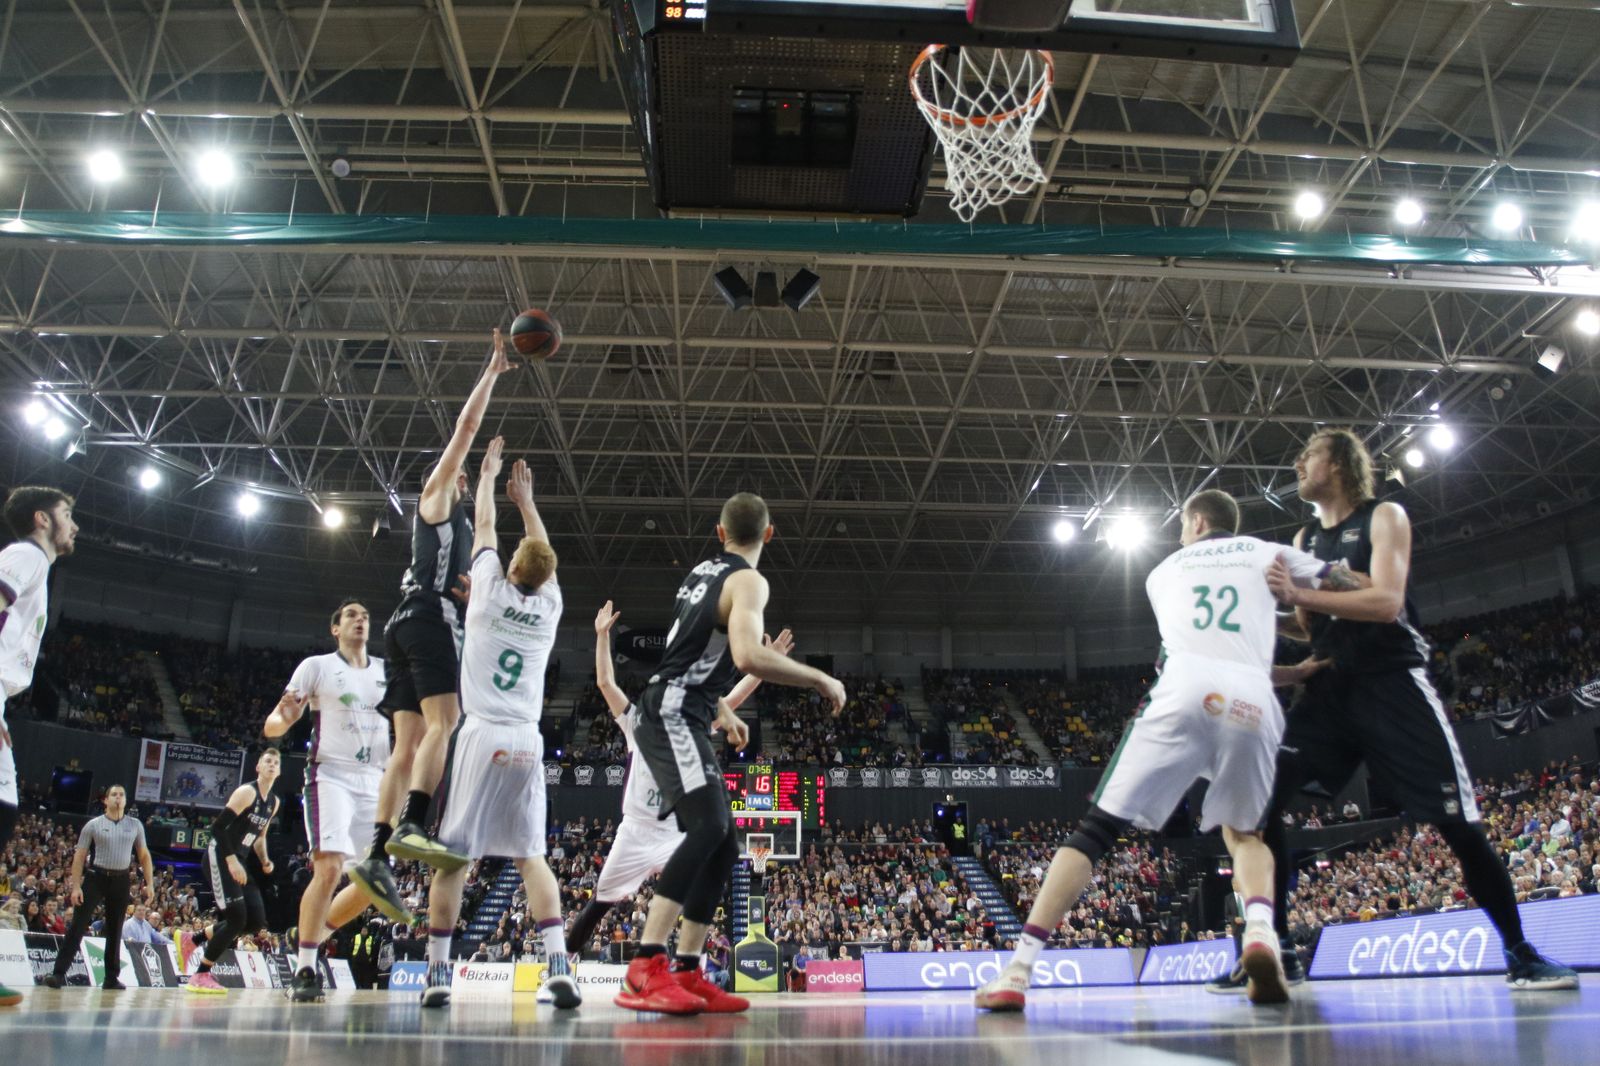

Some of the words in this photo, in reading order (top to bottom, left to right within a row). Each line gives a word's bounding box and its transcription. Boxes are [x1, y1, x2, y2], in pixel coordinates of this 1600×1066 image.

[1192, 584, 1241, 632] 32
[503, 606, 541, 626] DIAZ
[492, 648, 524, 691] 9
[748, 797, 772, 806] IMQ
[176, 831, 186, 843] B
[1349, 919, 1489, 974] endesa
[210, 961, 242, 976] utxabank
[740, 959, 768, 969] RETA
[1159, 943, 1227, 982] endesa
[466, 970, 509, 981] Bizkaia
[808, 971, 862, 985] endesa
[920, 953, 1083, 988] endsa
[577, 976, 589, 984] EL
[591, 975, 625, 985] CORRE
